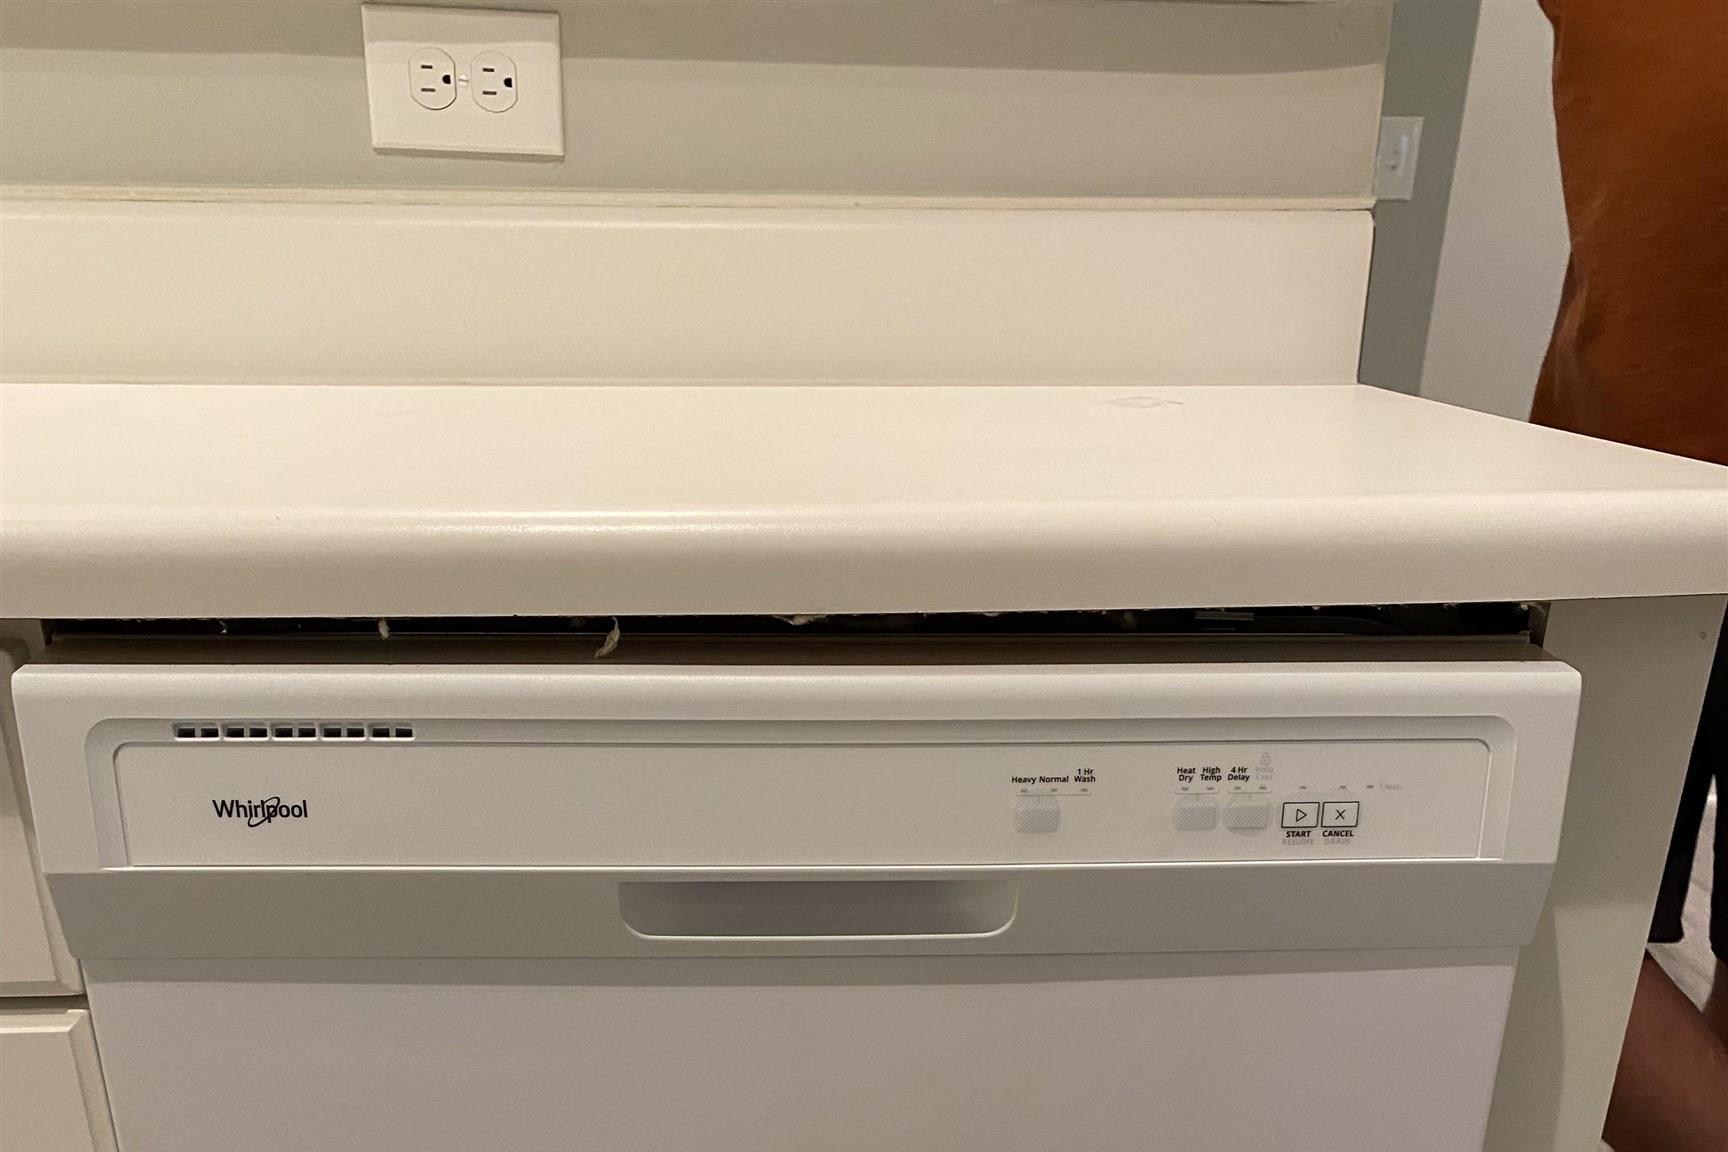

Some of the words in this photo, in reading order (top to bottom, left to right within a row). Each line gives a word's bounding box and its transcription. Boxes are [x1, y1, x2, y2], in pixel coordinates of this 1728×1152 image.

[1202, 766, 1221, 775] High
[1237, 766, 1248, 774] Hr
[1011, 776, 1037, 784] Heavy
[1074, 775, 1096, 783] Wash
[1178, 774, 1194, 783] Dry
[1200, 774, 1222, 782] Temp
[1227, 774, 1250, 782] Delay
[212, 797, 308, 827] Whirlpool
[1285, 830, 1312, 838] START
